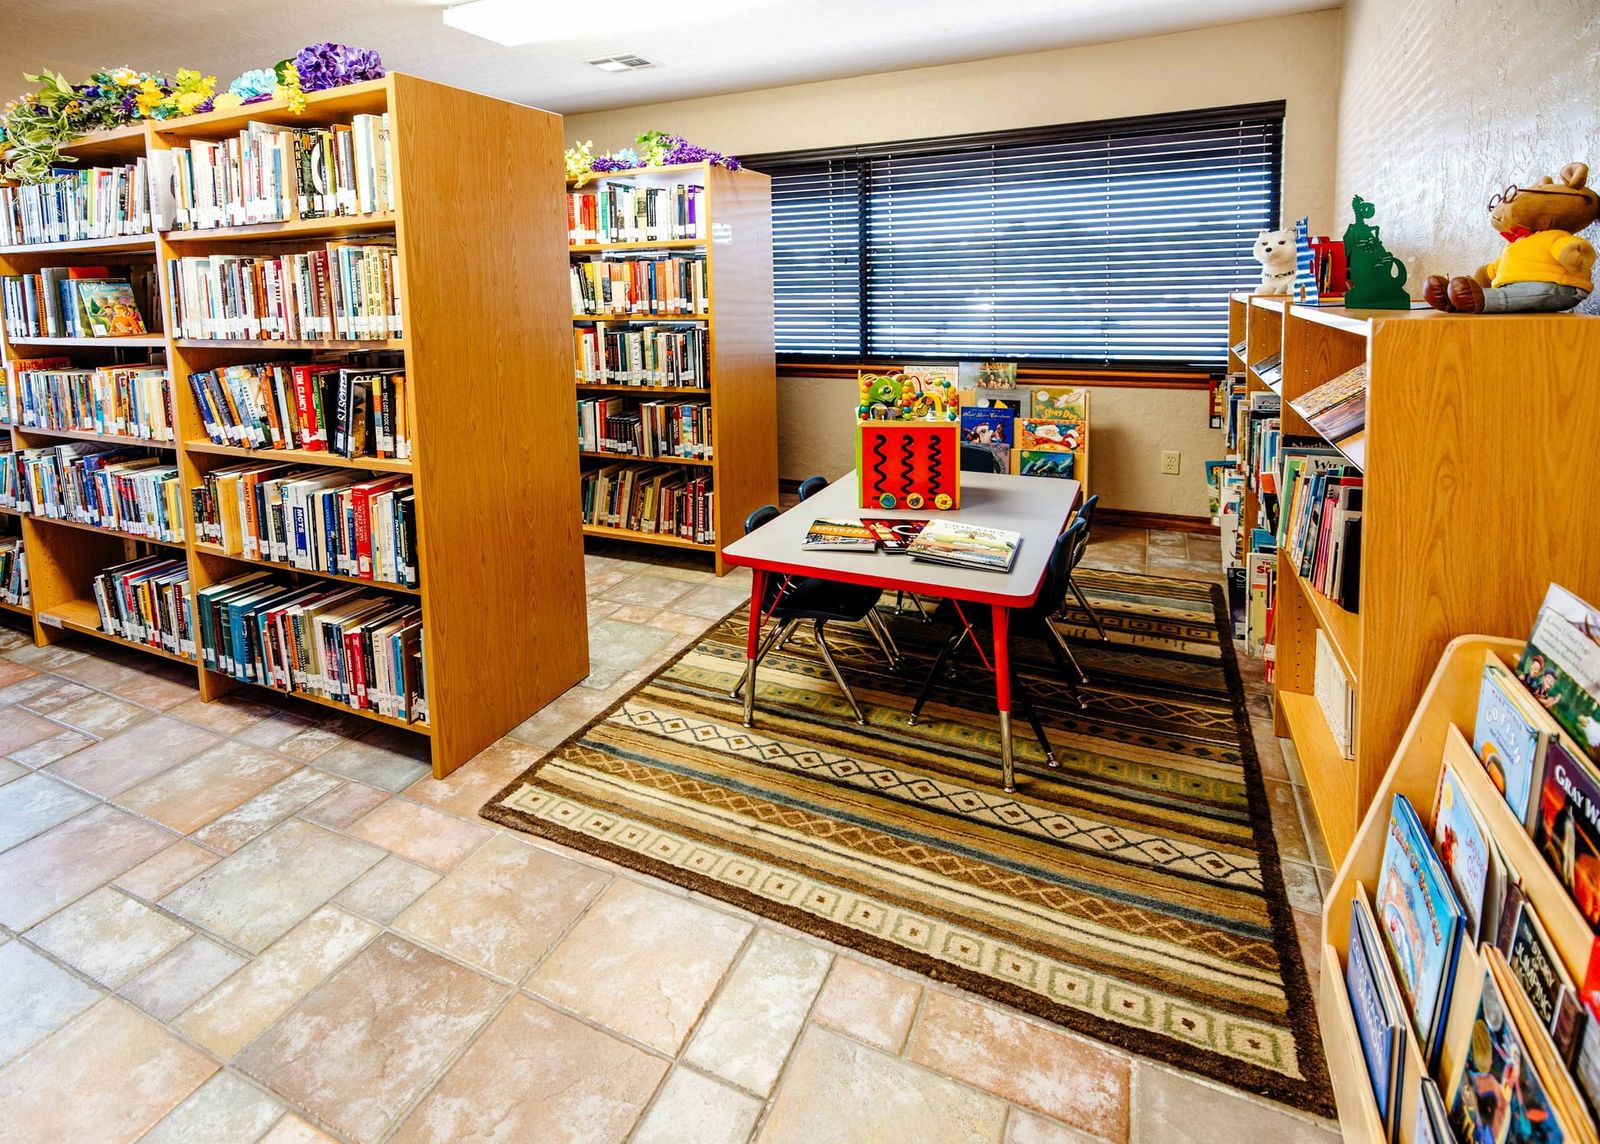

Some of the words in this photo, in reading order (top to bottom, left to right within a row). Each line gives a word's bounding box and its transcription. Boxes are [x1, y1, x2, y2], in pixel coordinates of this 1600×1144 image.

[294, 133, 304, 195] MANKILL
[296, 371, 304, 385] TOM
[297, 387, 307, 411] CLANCY
[1554, 764, 1584, 808] GRAY
